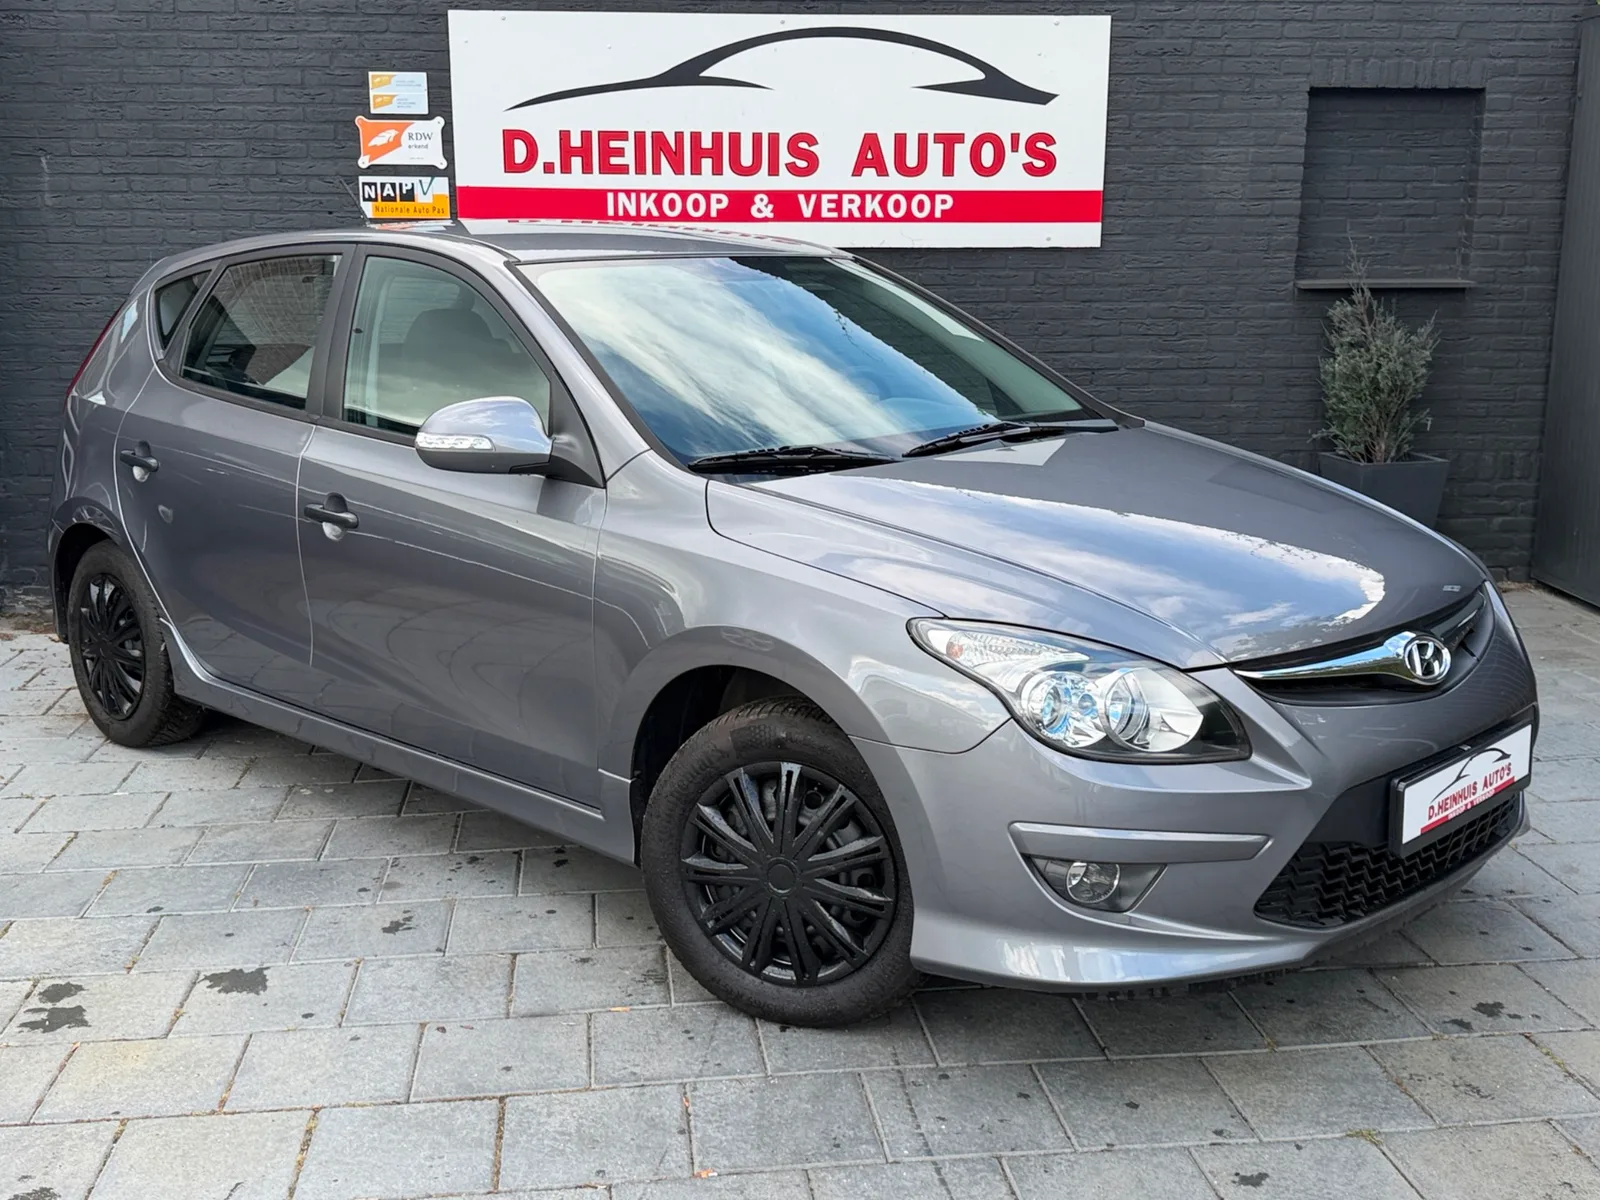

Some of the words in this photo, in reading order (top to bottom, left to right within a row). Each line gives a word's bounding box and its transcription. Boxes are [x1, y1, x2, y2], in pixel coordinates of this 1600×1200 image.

[408, 132, 434, 141] RDW
[502, 128, 820, 177] D.HEINHUIS
[852, 132, 1058, 178] AUTO'S
[375, 205, 410, 214] Nationale
[413, 205, 430, 214] Auto
[432, 205, 445, 214] Pas
[606, 191, 729, 218] INKOOP
[750, 194, 775, 219] &
[798, 192, 954, 219] VERKOOP
[1427, 781, 1478, 821] D.HEINHUIS
[1482, 763, 1512, 791] AUTO'S
